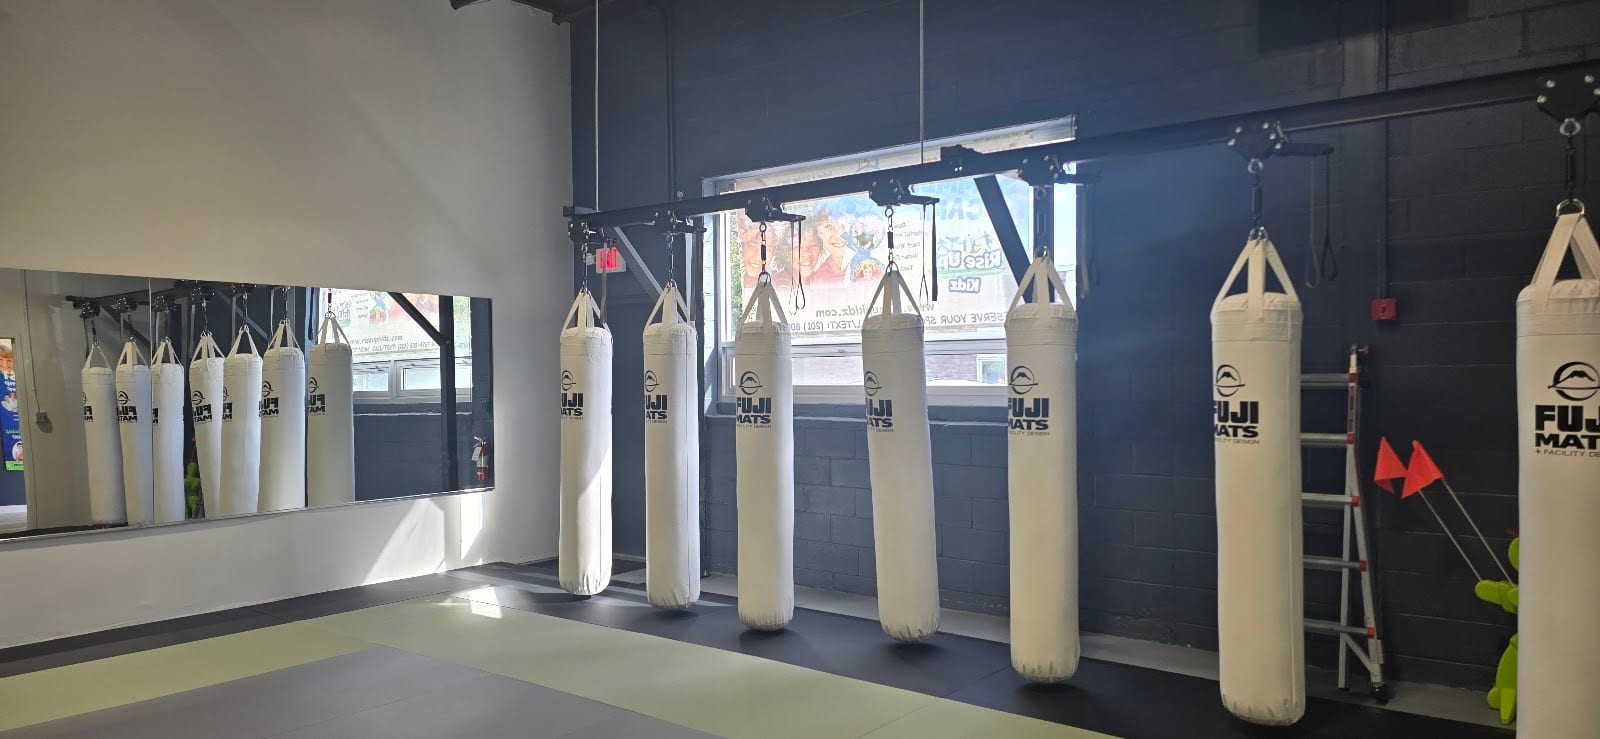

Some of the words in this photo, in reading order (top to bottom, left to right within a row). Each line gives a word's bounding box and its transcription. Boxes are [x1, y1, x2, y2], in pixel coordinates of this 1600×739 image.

[561, 392, 583, 407] UJI
[645, 394, 667, 410] UJI
[737, 397, 771, 413] FUJI
[737, 414, 771, 424] MATS
[1535, 405, 1600, 433] FUJ
[1535, 432, 1600, 450] MAT
[1544, 449, 1586, 457] FACILITY
